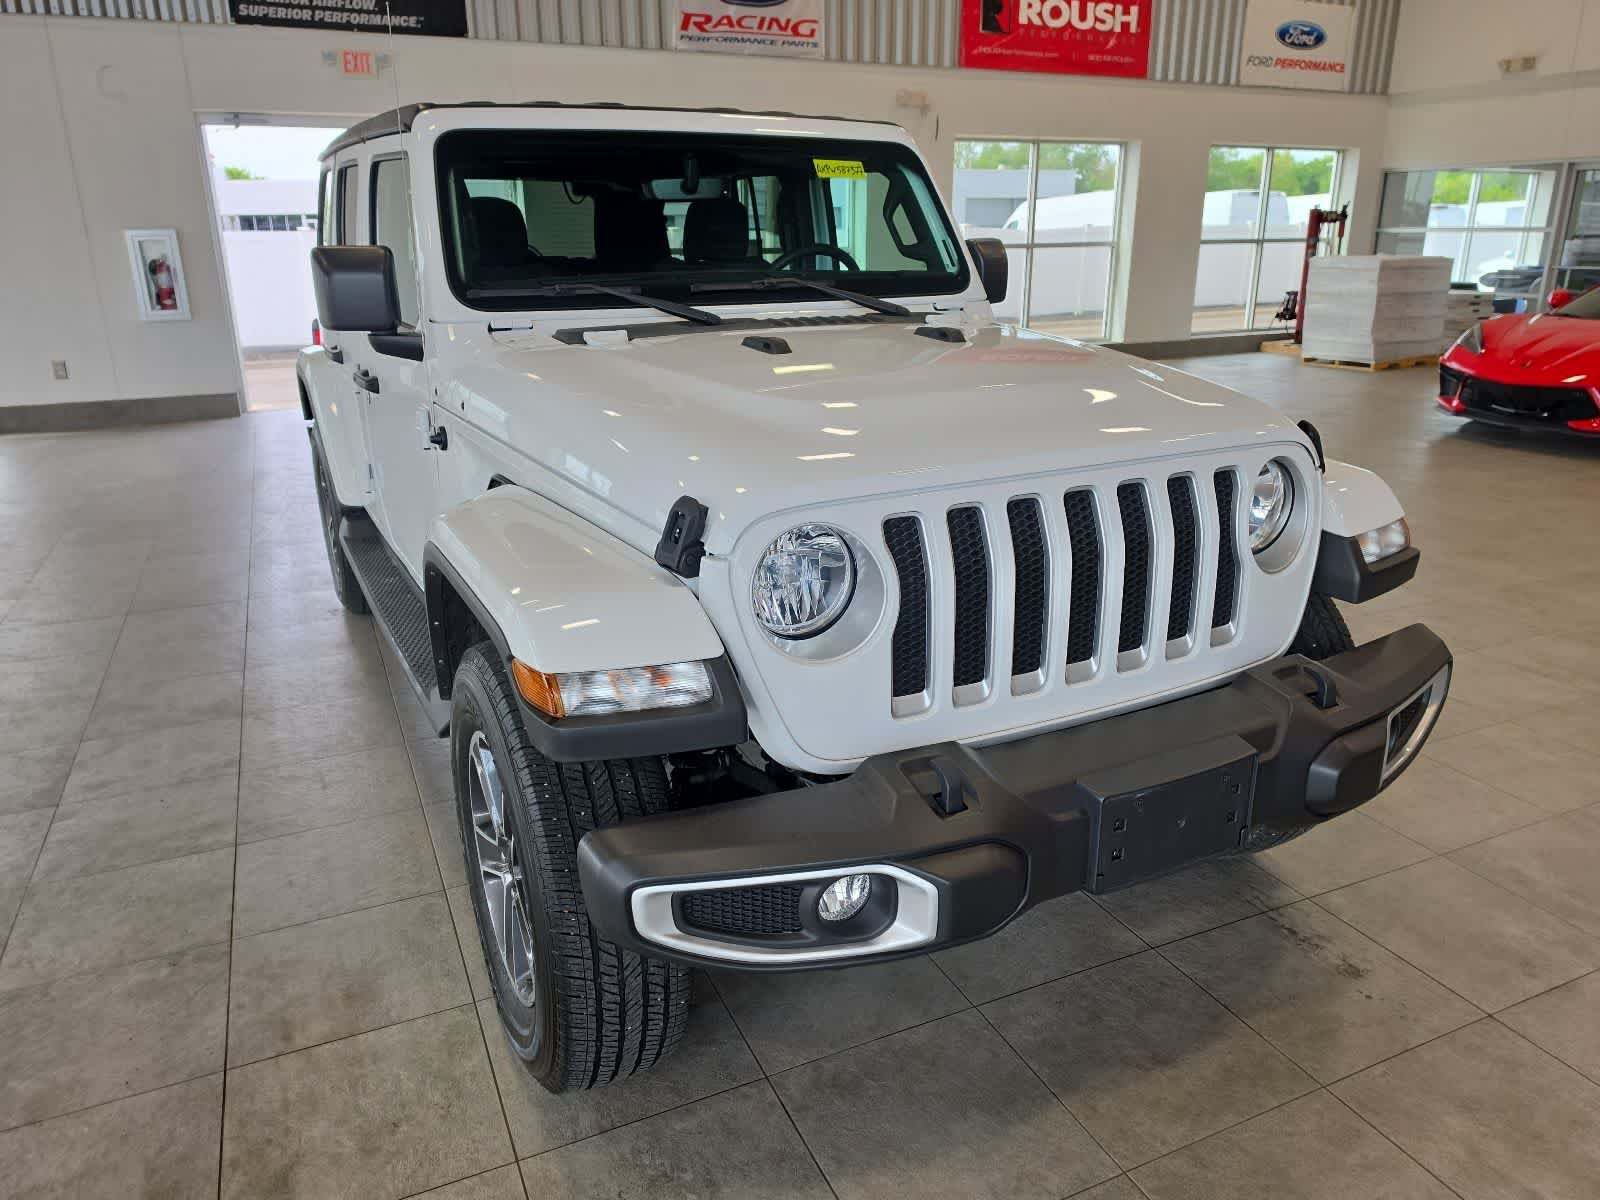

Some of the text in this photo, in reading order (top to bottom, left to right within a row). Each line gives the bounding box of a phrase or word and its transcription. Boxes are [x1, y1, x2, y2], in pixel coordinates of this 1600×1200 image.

[238, 4, 312, 21] SUPERIOR
[1018, 0, 1140, 33] ROUSH
[680, 11, 819, 38] RACING
[1284, 24, 1317, 46] Ford
[680, 34, 819, 48] PERFORMANCE PARTS
[343, 51, 371, 74] EXIT
[1247, 55, 1345, 73] FORD PERFORMANCE
